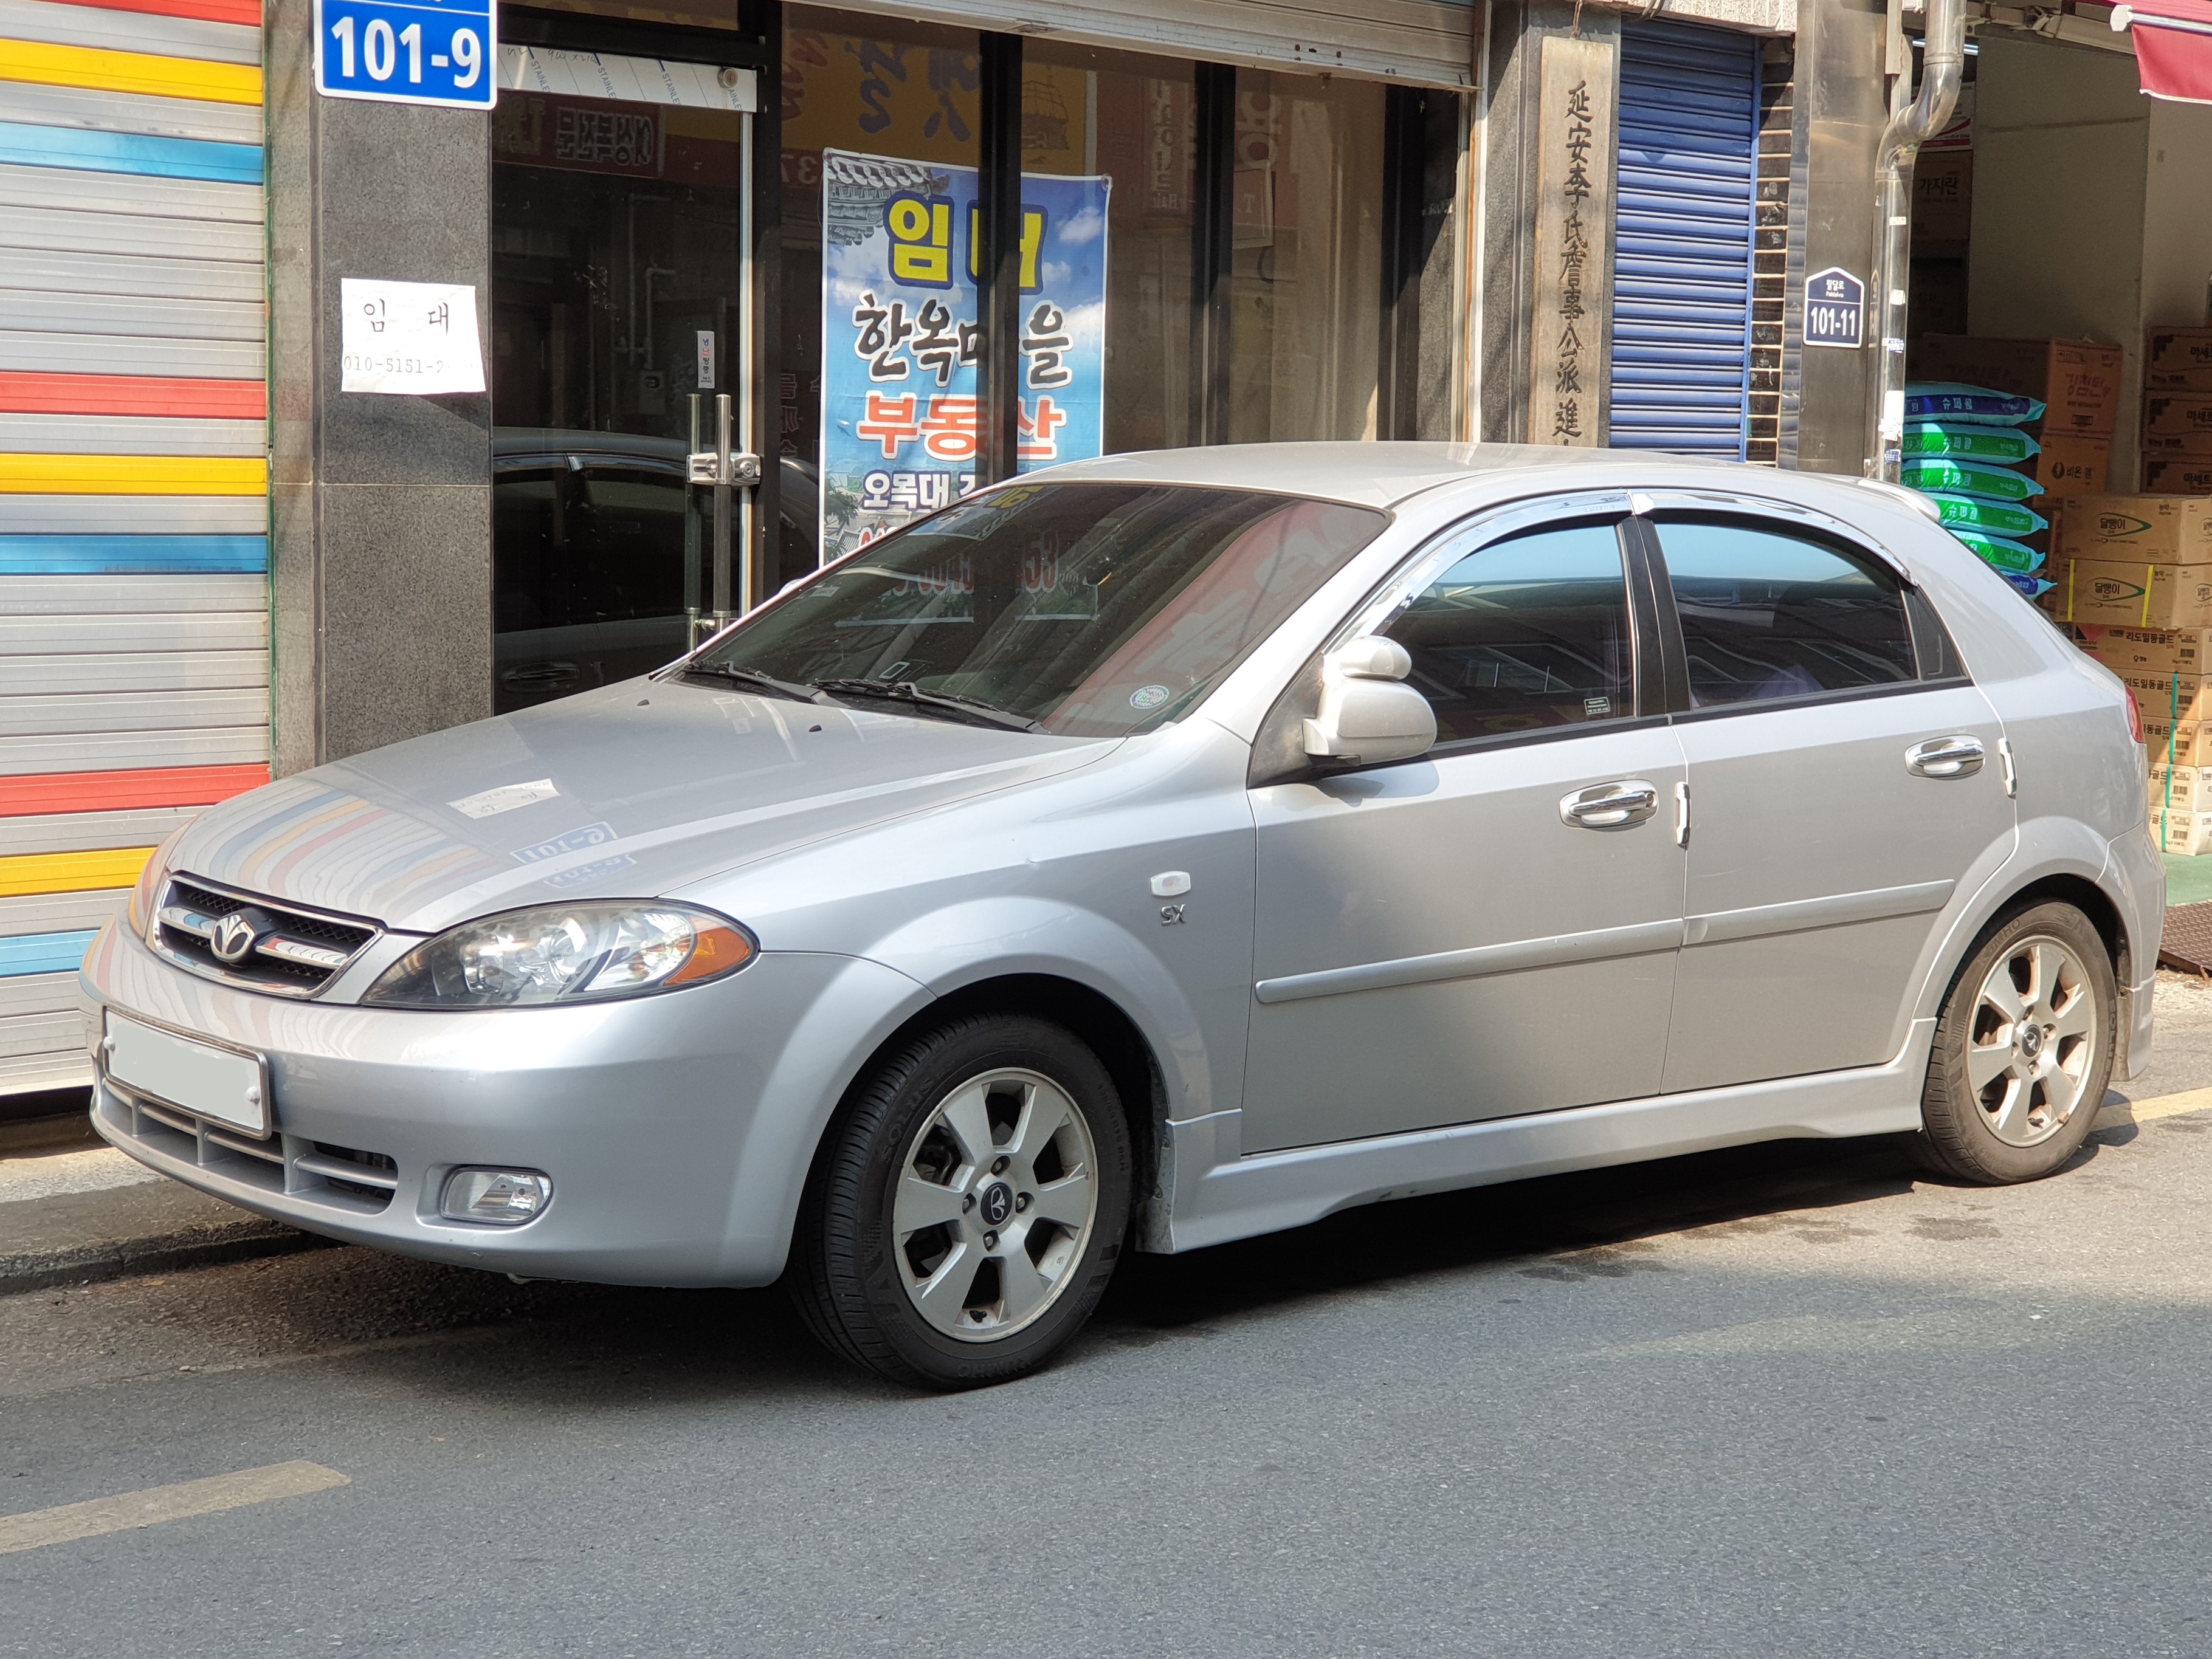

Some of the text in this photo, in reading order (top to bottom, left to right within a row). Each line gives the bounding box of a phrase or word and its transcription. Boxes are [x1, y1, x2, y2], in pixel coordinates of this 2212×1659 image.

[331, 16, 481, 89] 101-9
[597, 67, 618, 99] STAINLE
[1552, 80, 1595, 447] 延安李氏詹事公派進
[1826, 280, 1844, 290] 팔달로
[1810, 306, 1856, 337] 101-11
[864, 473, 949, 509] 오목대
[1160, 904, 1186, 926] SX
